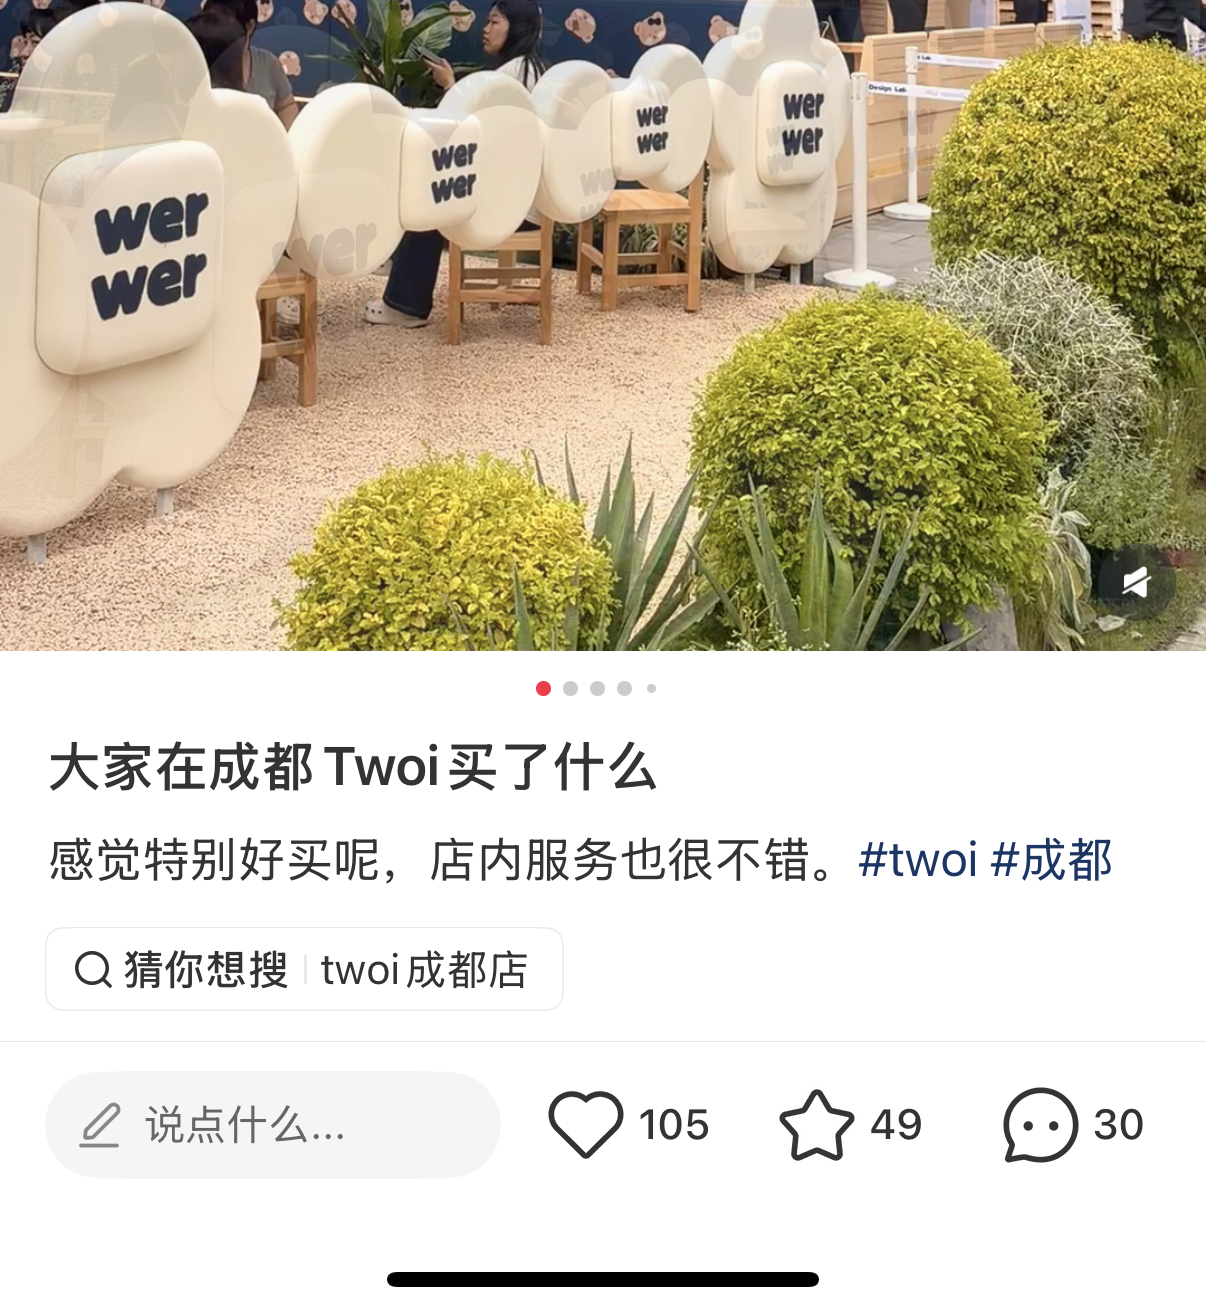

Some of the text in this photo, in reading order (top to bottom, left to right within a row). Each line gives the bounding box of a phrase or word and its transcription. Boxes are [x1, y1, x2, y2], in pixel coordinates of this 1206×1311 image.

[636, 105, 669, 129] wer
[783, 92, 825, 121] wer
[637, 130, 669, 155] wer
[782, 126, 824, 157] wer
[431, 142, 478, 172] wer
[431, 173, 477, 205] wer
[94, 192, 209, 256] wer
[90, 252, 207, 321] wer
